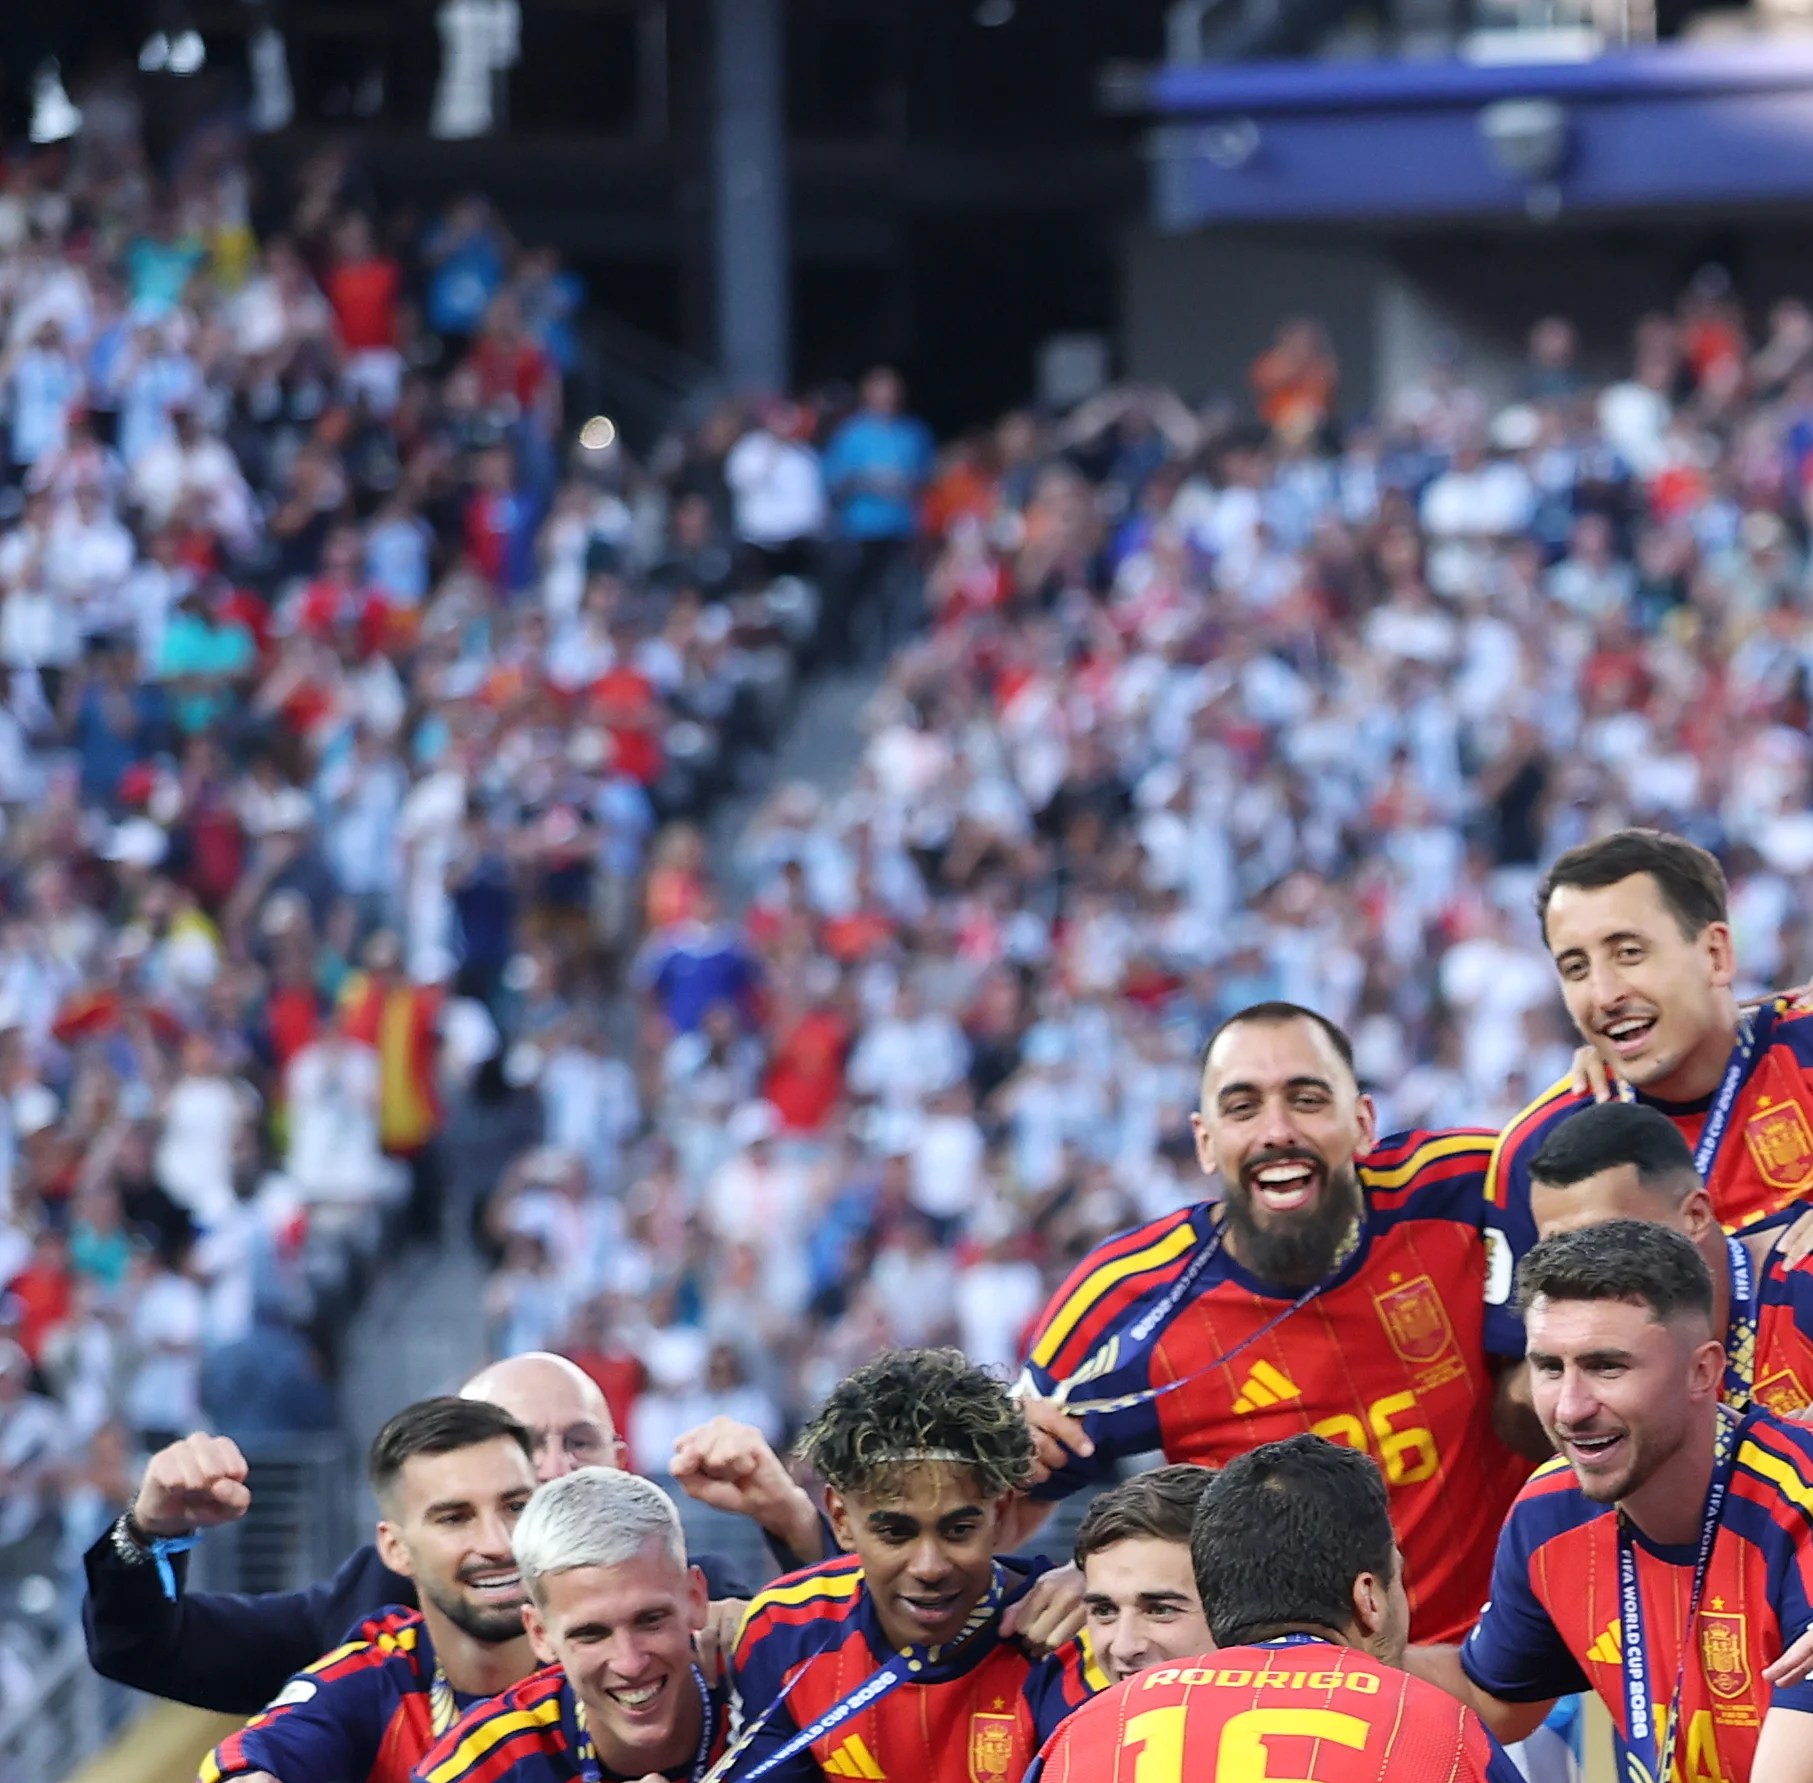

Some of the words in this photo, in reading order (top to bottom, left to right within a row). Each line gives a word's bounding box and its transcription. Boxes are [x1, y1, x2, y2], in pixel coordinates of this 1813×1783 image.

[1694, 1136, 1717, 1175] ORLD
[1733, 1266, 1750, 1302] FIFA
[1707, 1483, 1725, 1526] FIFA
[1621, 1549, 1636, 1588] FIFA
[1623, 1591, 1641, 1645] WORLD
[1142, 1668, 1381, 1695] RODRIGO
[1627, 1645, 1644, 1681] CUP
[744, 1759, 778, 1780] FIFA
[773, 1724, 825, 1760] WORLD
[820, 1703, 851, 1728] CUP
[846, 1671, 898, 1710] 2026
[1628, 1681, 1649, 1740] 2026
